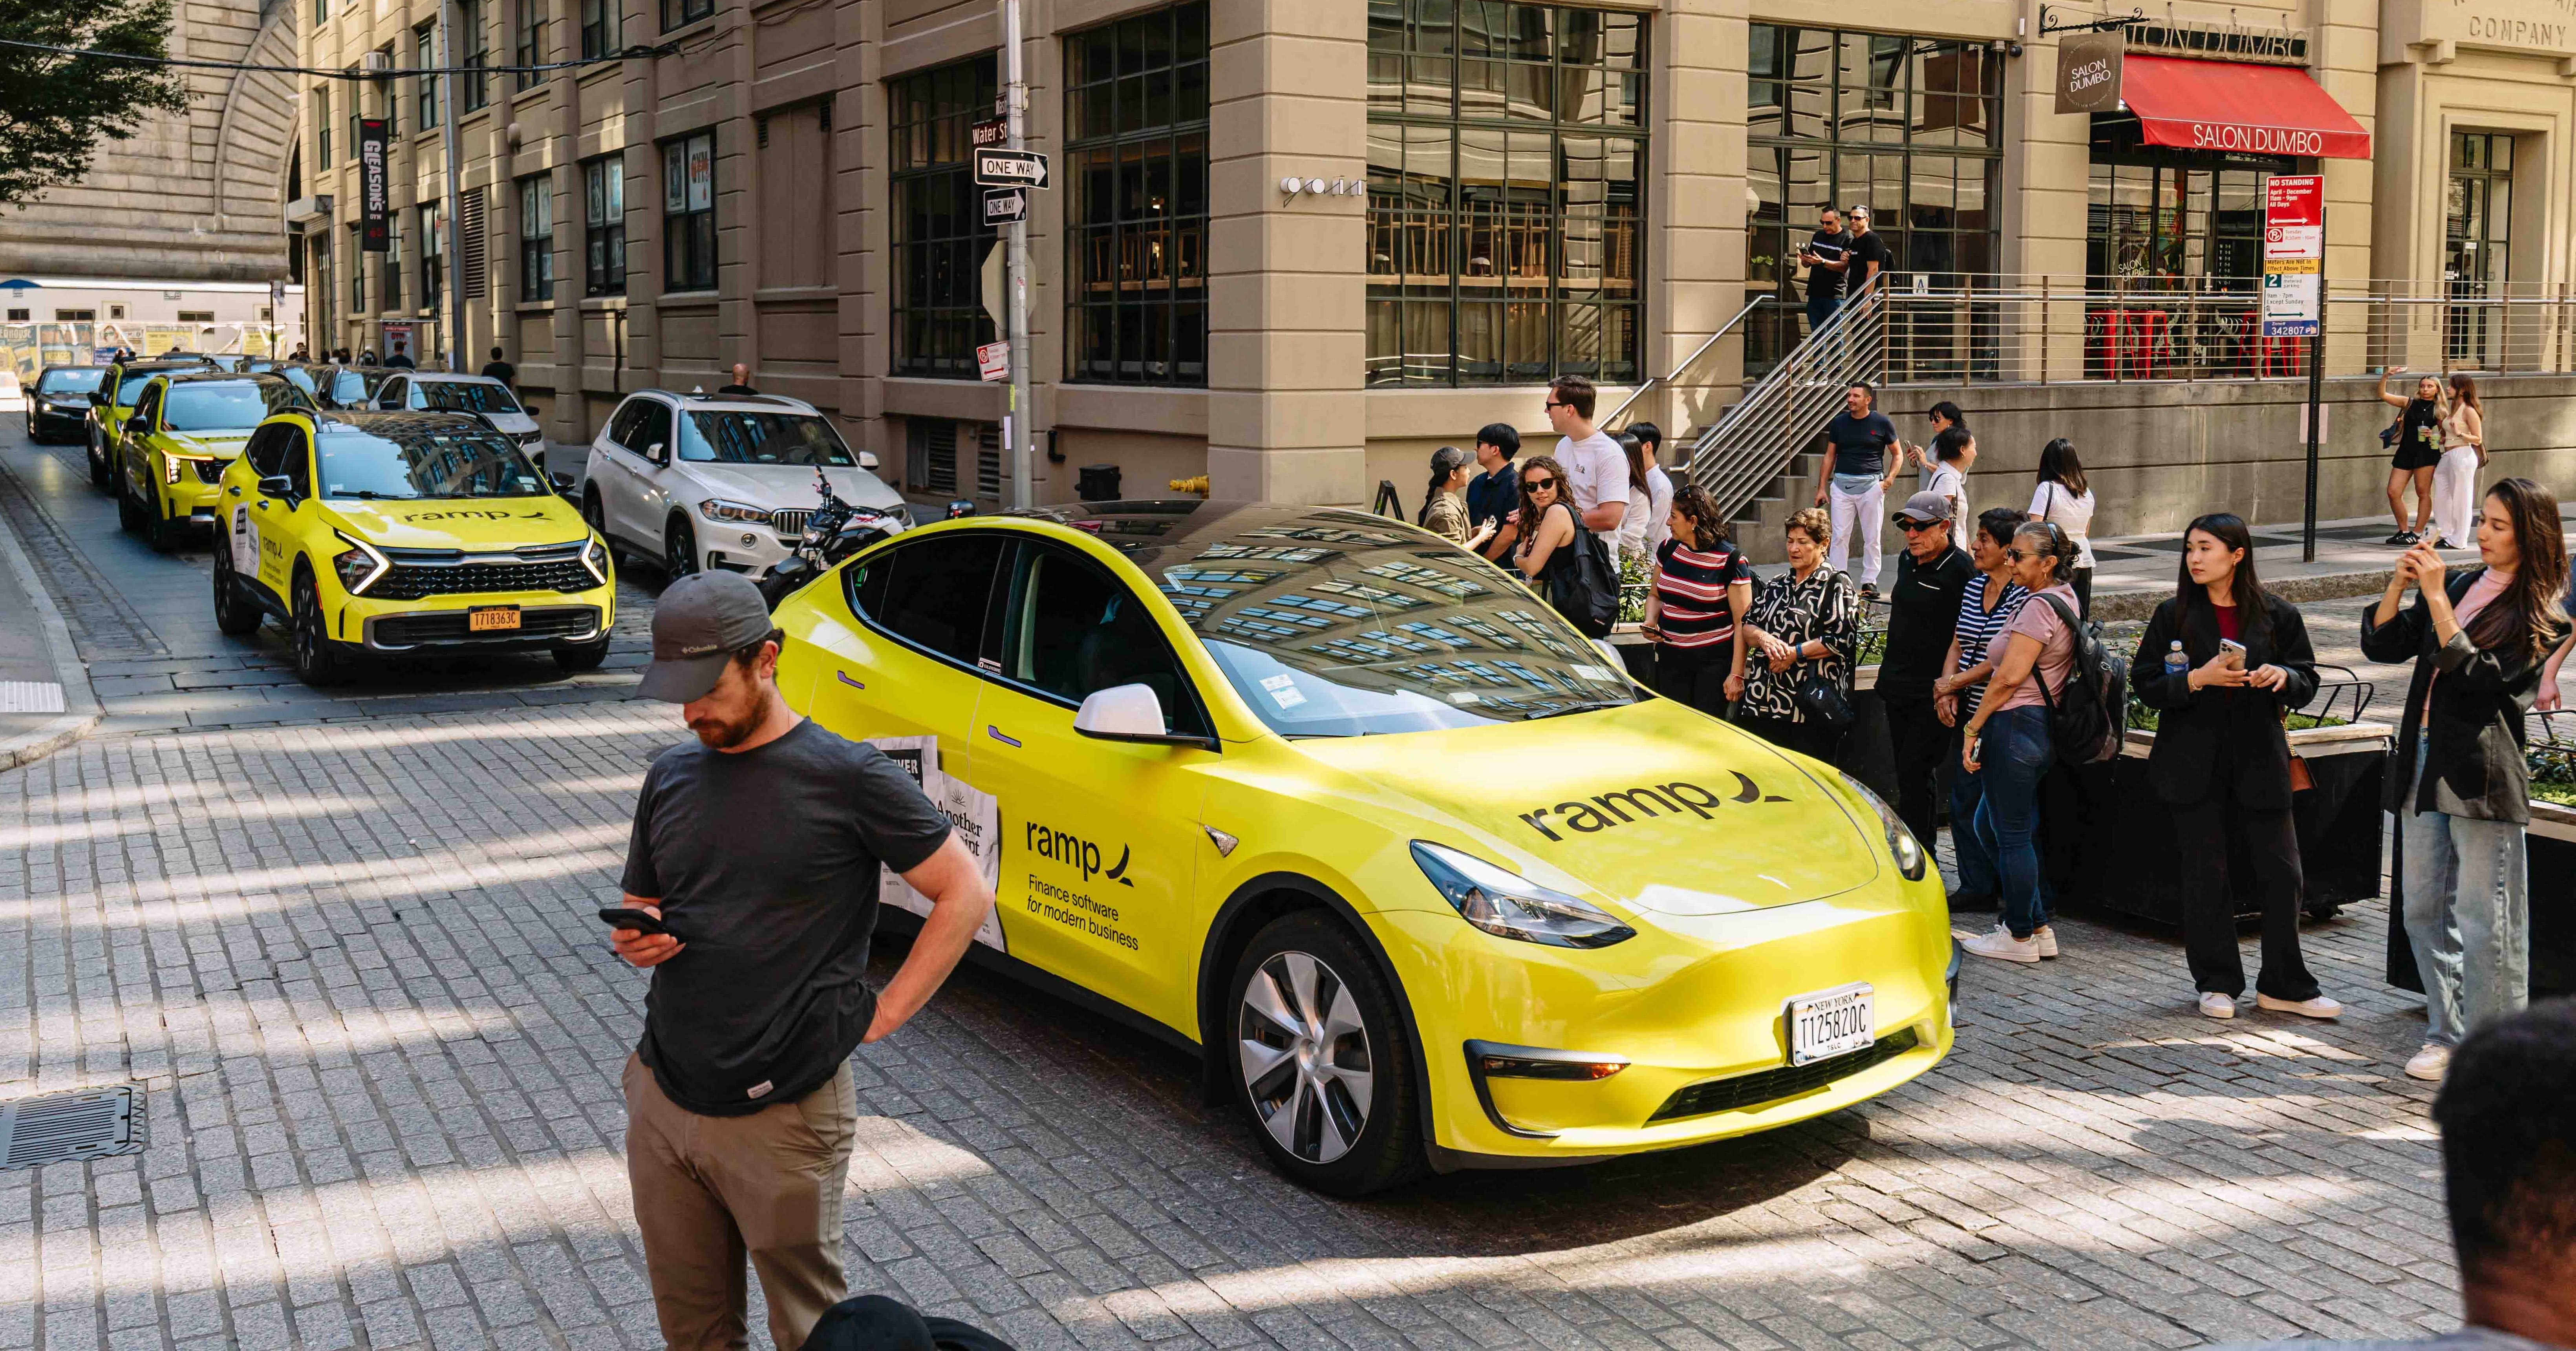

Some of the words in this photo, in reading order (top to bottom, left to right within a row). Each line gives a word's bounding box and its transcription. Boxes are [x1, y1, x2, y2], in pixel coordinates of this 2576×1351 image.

[2470, 16, 2566, 46] COMPANY
[2203, 24, 2310, 64] DUMBO
[2072, 58, 2106, 79] SALON
[2070, 70, 2111, 92] DUMBO
[972, 126, 997, 144] Water
[999, 122, 1007, 139] St
[2194, 124, 2250, 150] SALON
[2256, 128, 2322, 154] DUMBO
[987, 161, 1011, 174] ONE
[1016, 162, 1034, 176] WAY
[990, 201, 1001, 214] ONE
[1003, 199, 1015, 212] WAY
[2119, 258, 2141, 273] SALON
[2119, 267, 2145, 282] UMBO
[1916, 278, 1925, 293] A
[2269, 274, 2278, 287] 2
[2272, 327, 2304, 335] 342807
[403, 510, 510, 522] ramp
[475, 612, 516, 625] T718363C
[937, 800, 982, 837] Another
[1518, 782, 1720, 842] ramp
[1027, 821, 1100, 882] ramp
[1029, 874, 1069, 903] Finance
[1072, 894, 1119, 921] software
[1027, 895, 1042, 914] for
[1044, 905, 1085, 931] modern
[1089, 917, 1138, 951] business
[1815, 1000, 1833, 1012] NEW
[1834, 994, 1853, 1007] YORK
[1801, 1004, 1866, 1049] T125820C
